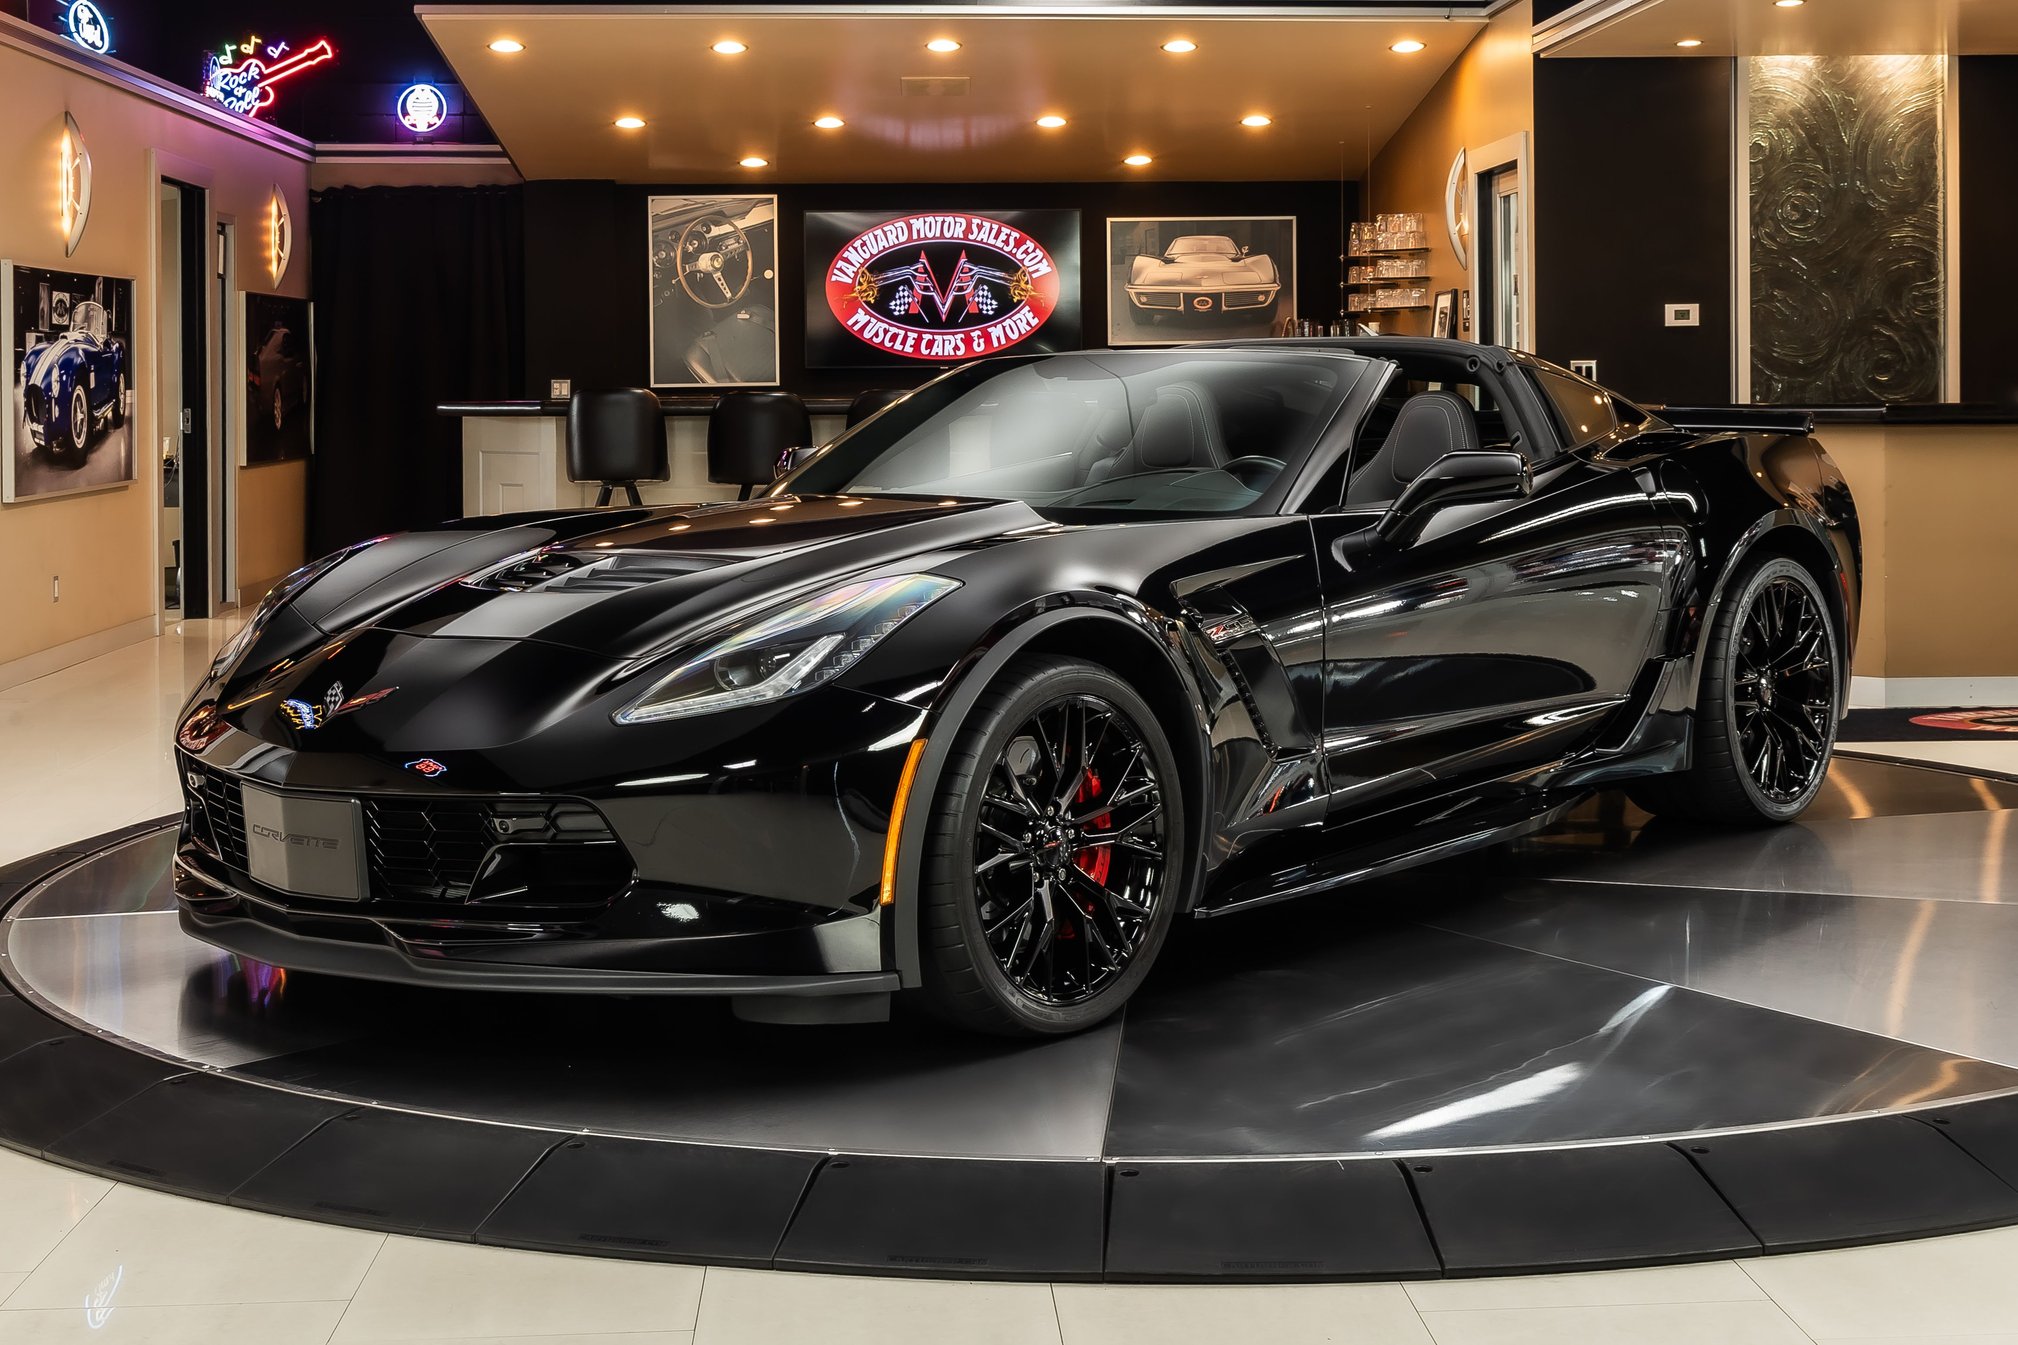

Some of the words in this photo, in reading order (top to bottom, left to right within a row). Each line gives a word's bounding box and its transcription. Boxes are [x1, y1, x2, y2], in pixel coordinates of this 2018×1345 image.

[218, 62, 260, 91] Rock
[830, 221, 909, 284] VANGUARD
[909, 215, 967, 240] MOTOR
[968, 218, 1053, 279] SALES.COM
[846, 307, 918, 354] MUSCLE
[920, 333, 966, 357] CARS
[972, 332, 986, 353] &
[987, 305, 1040, 348] MORE
[252, 823, 340, 850] CORVETTE
